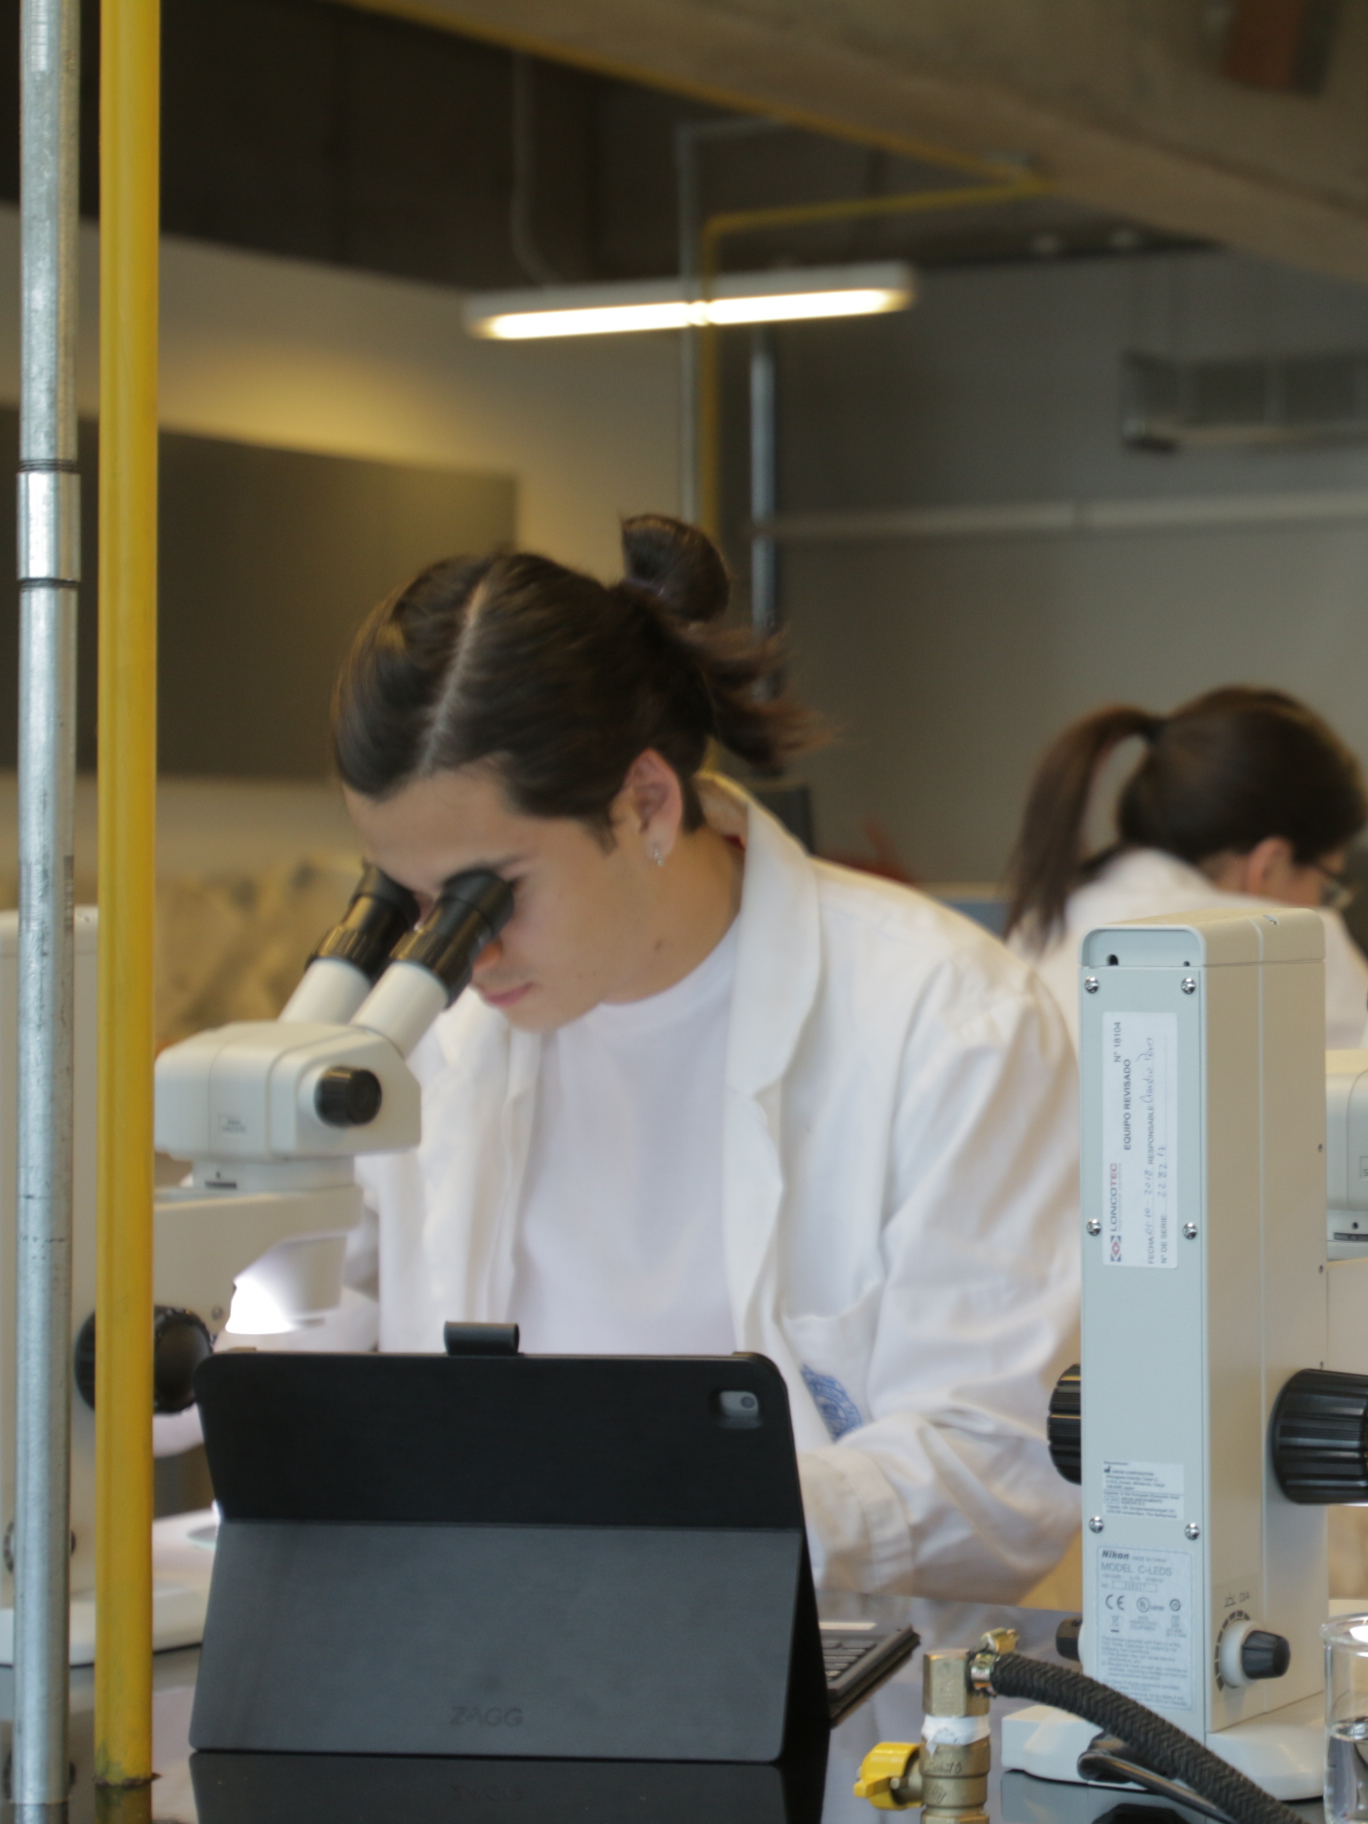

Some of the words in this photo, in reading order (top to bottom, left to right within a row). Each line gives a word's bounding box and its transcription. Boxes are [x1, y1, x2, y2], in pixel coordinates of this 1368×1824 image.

[1113, 1021, 1121, 1048] 18104
[1123, 1058, 1132, 1110] REVISADO
[1123, 1112, 1132, 1151] EQUIPO
[1109, 1162, 1118, 1232] LONCOTEC
[1101, 1549, 1130, 1561] Nikon
[1101, 1562, 1133, 1574] MODEL
[1137, 1564, 1173, 1577] C-LEDS
[449, 1704, 524, 1729] ZAGG
